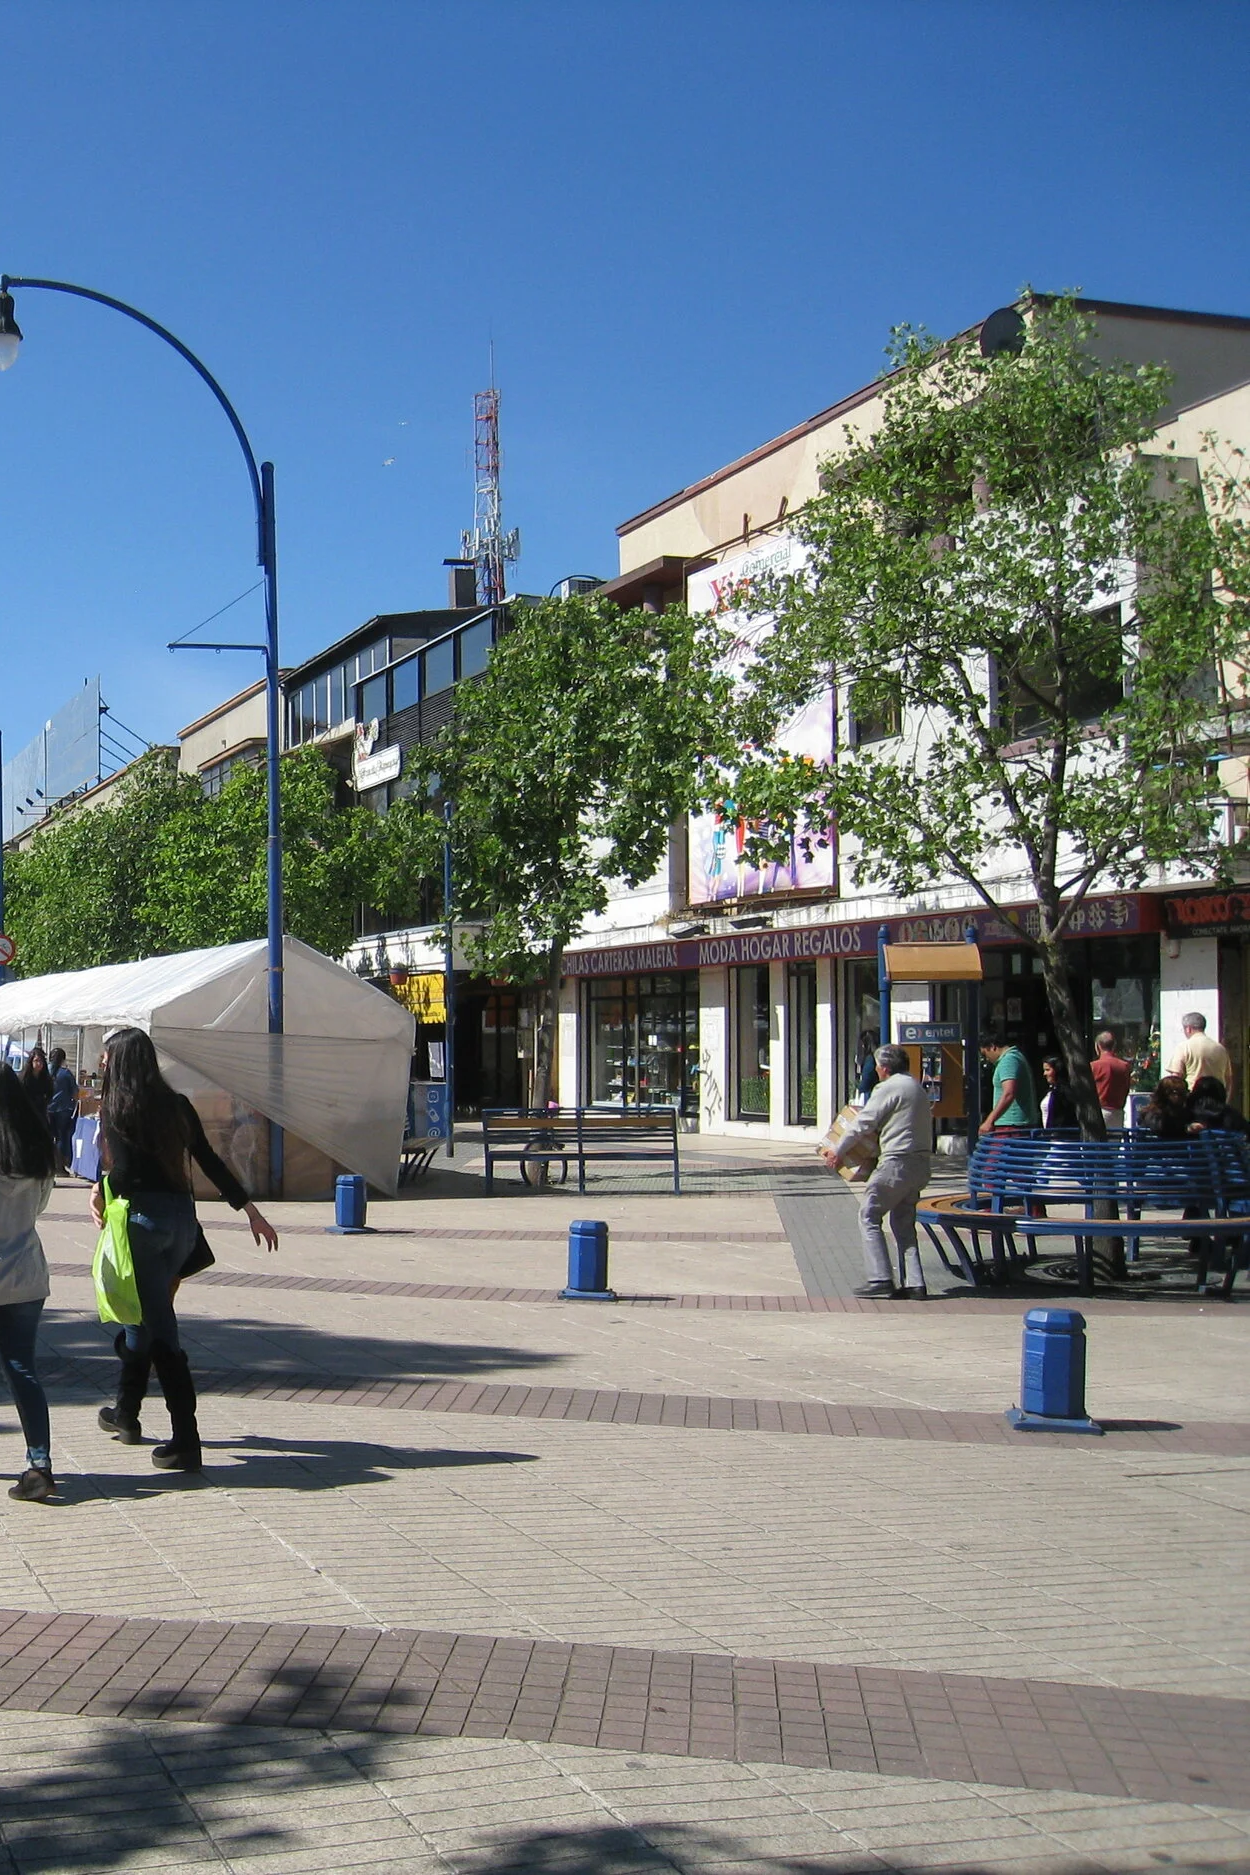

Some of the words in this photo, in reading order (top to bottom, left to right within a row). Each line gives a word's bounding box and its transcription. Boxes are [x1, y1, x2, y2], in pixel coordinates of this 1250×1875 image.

[740, 541, 791, 575] Comercial
[590, 948, 636, 973] CARTERAS
[636, 944, 678, 969] MALETAS
[699, 941, 738, 964] MODA
[741, 934, 790, 961] HOGAR
[794, 925, 861, 956] REGALOS
[925, 1028, 954, 1038] entel
